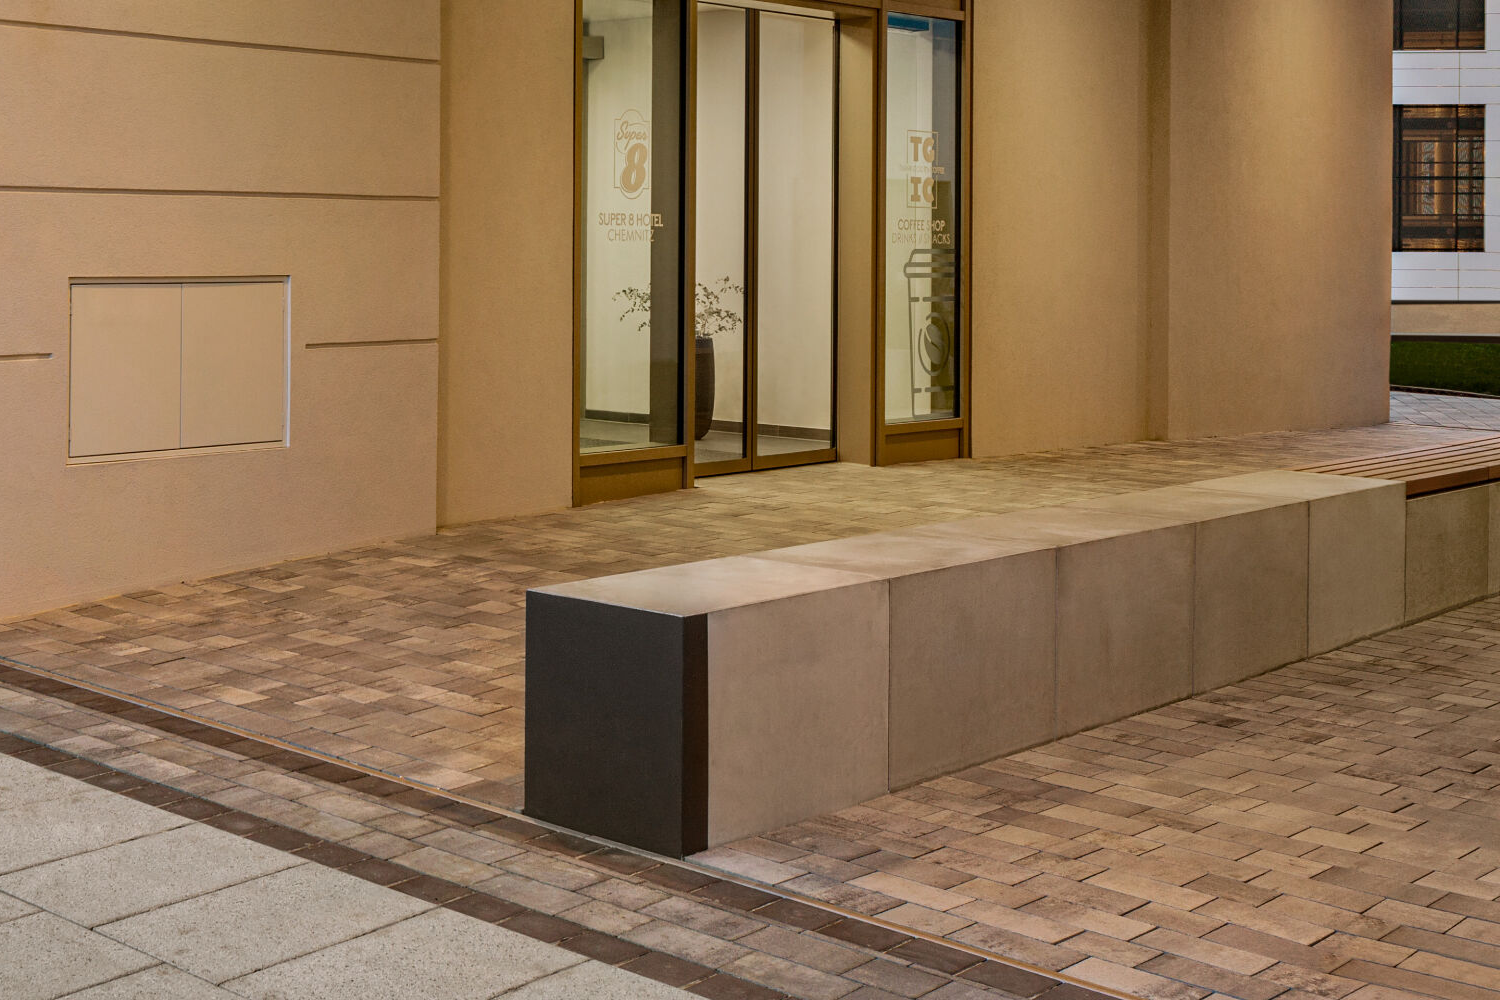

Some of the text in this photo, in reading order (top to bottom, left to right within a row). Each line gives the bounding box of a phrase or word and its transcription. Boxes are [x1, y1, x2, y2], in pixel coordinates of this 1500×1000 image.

[616, 120, 647, 150] Super
[910, 136, 935, 163] TG
[621, 142, 647, 193] 8
[598, 212, 664, 227] SUPER 8 HOTEL
[897, 219, 946, 232] COFFEE SHOP
[607, 228, 655, 242] CHEMNITZ
